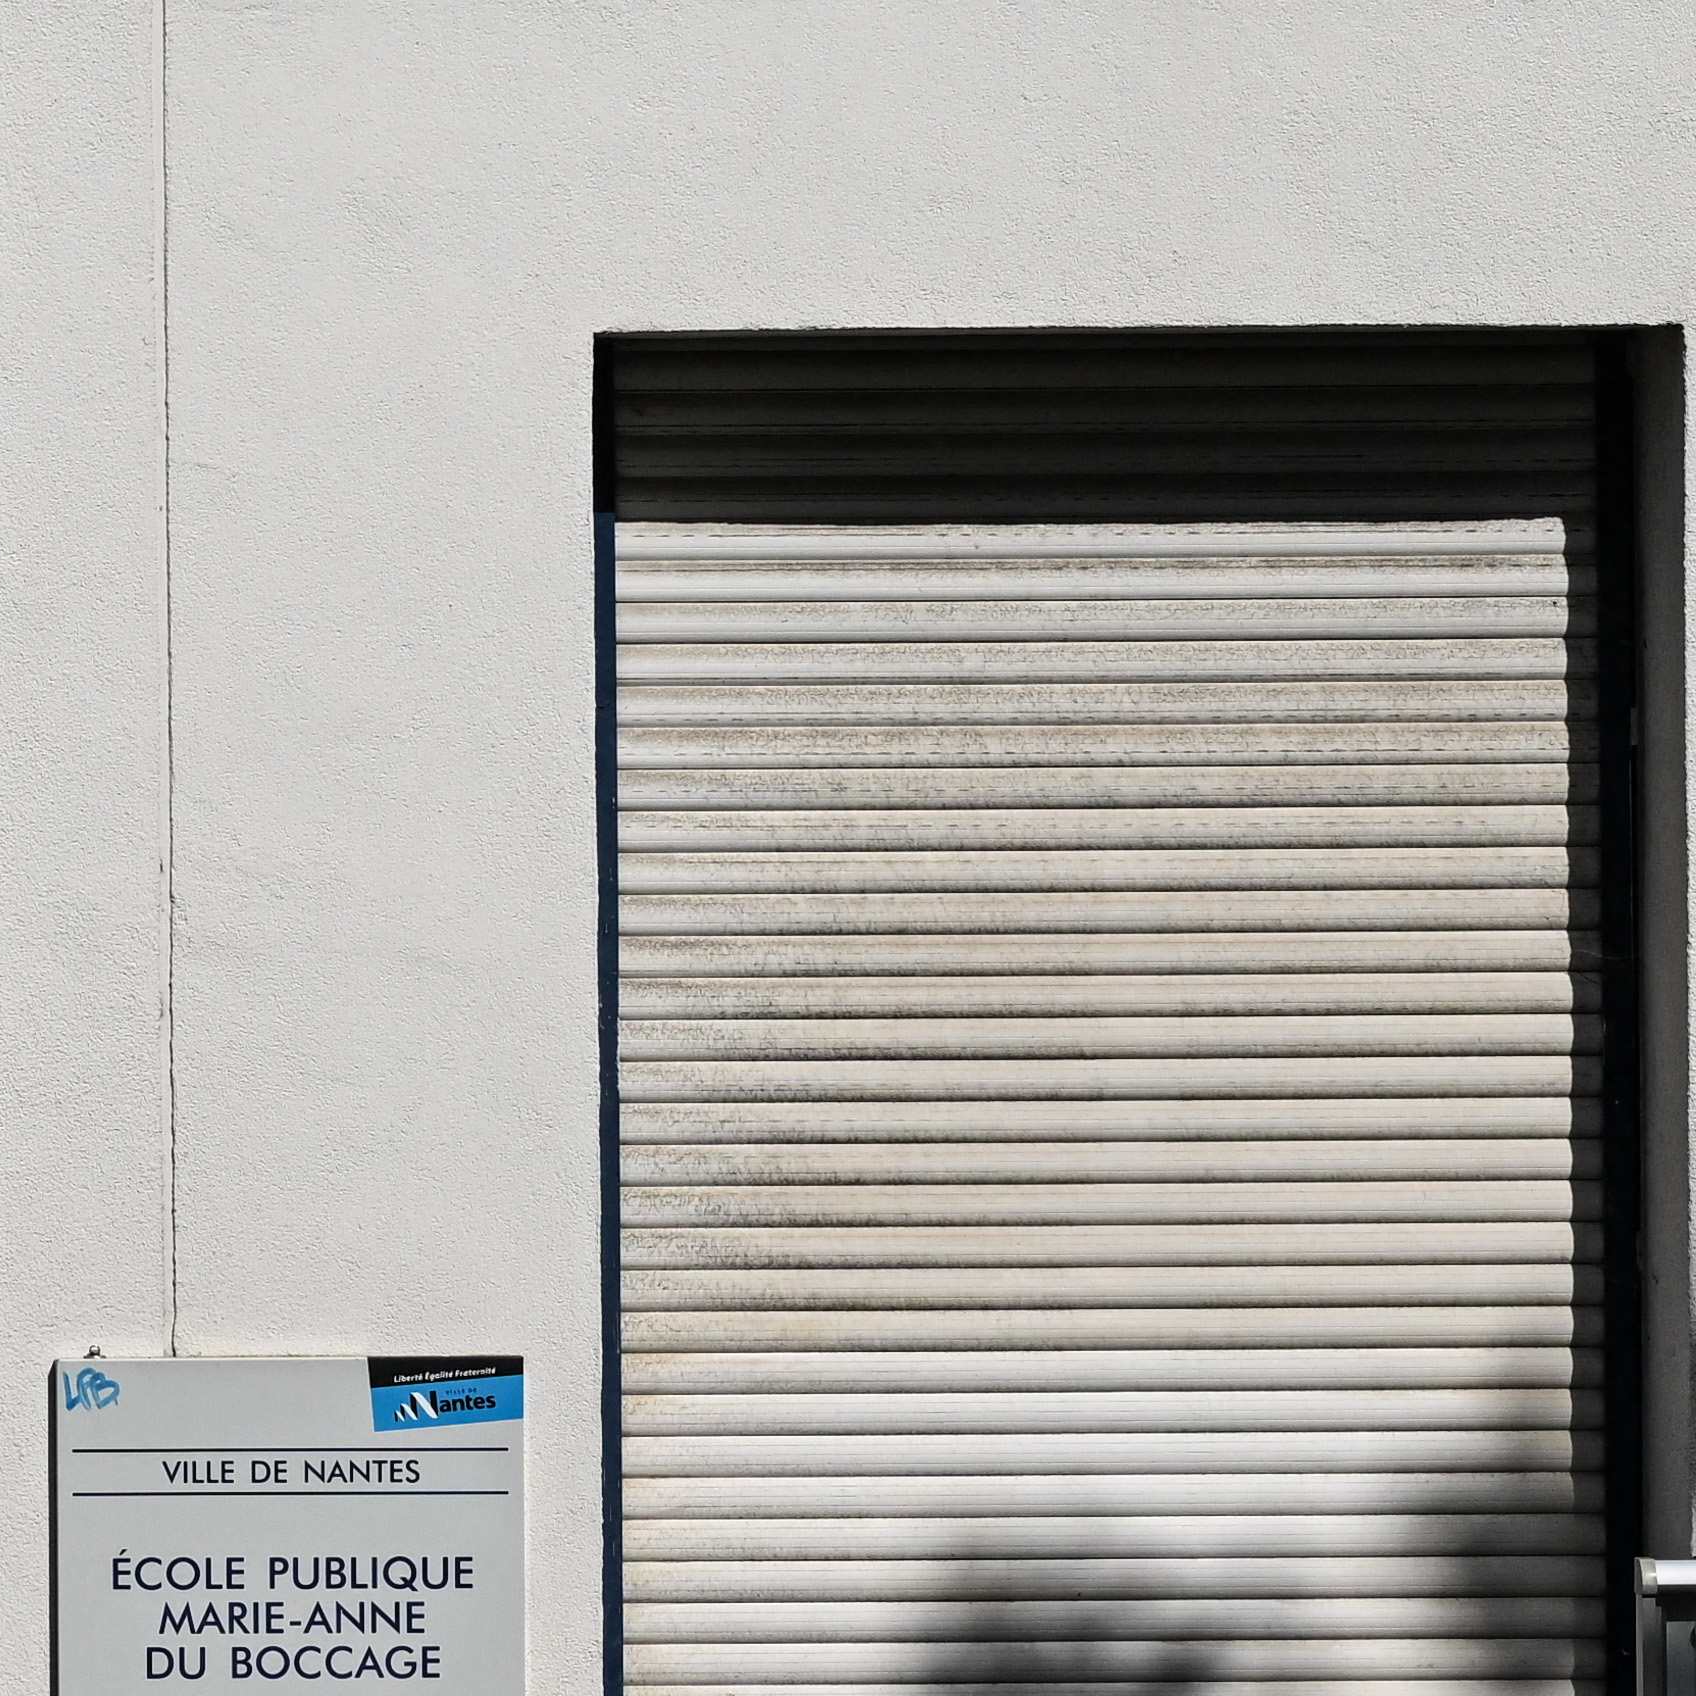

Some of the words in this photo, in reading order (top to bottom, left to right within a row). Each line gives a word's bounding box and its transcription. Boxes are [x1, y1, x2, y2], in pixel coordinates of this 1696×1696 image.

[394, 1373, 423, 1383] Liberté
[410, 1391, 497, 1419] Nantes
[162, 1461, 234, 1483] VILLE
[252, 1461, 287, 1483] DE
[305, 1460, 419, 1483] NANTES
[113, 1549, 244, 1590] ÉCOLE
[270, 1556, 473, 1591] PUBLIQUE
[159, 1601, 424, 1634] MARIE-ANNE
[147, 1647, 205, 1679] DU
[232, 1646, 440, 1679] BOCCAGE
